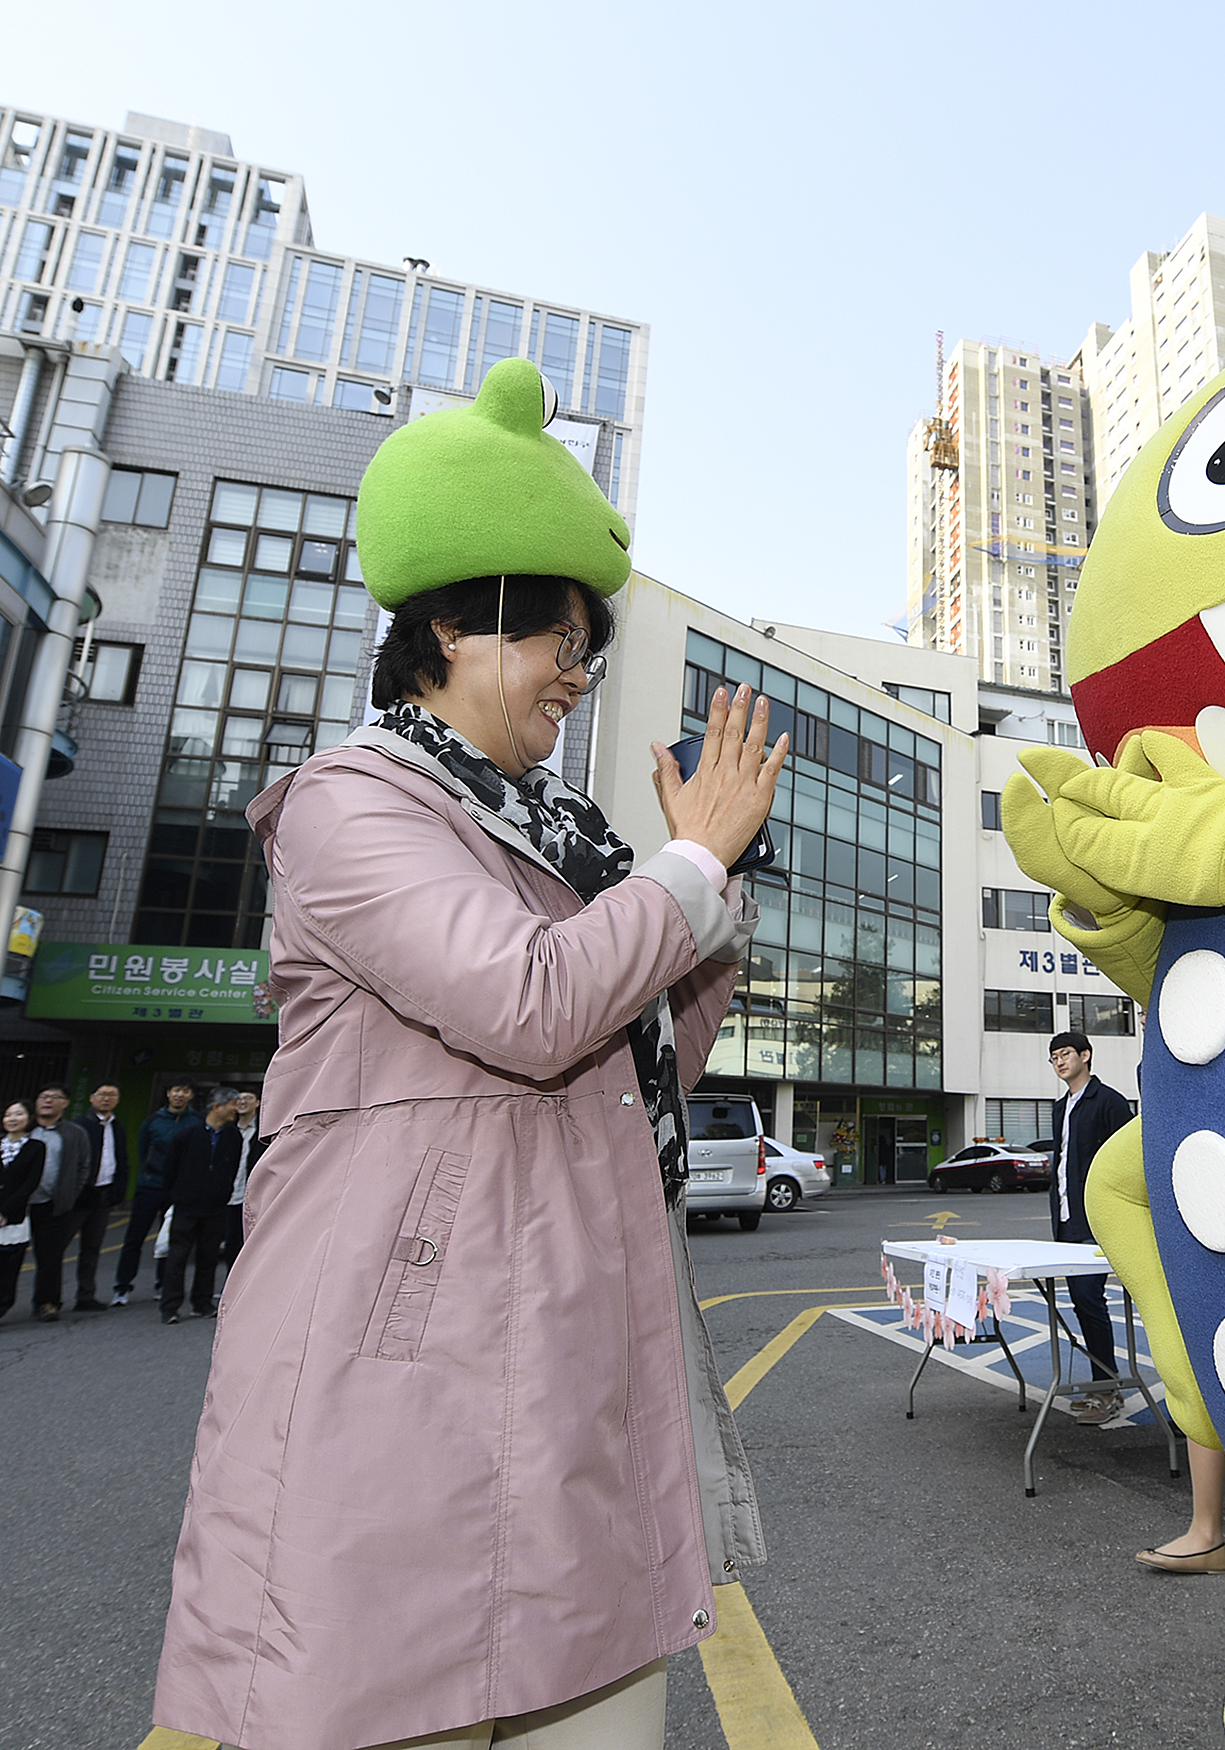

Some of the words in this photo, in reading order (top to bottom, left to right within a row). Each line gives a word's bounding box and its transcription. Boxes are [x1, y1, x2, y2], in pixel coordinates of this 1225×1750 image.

[87, 953, 260, 985] 민원봉사실
[91, 984, 142, 996] Citizen
[143, 986, 197, 998] Service
[198, 988, 248, 999] Center
